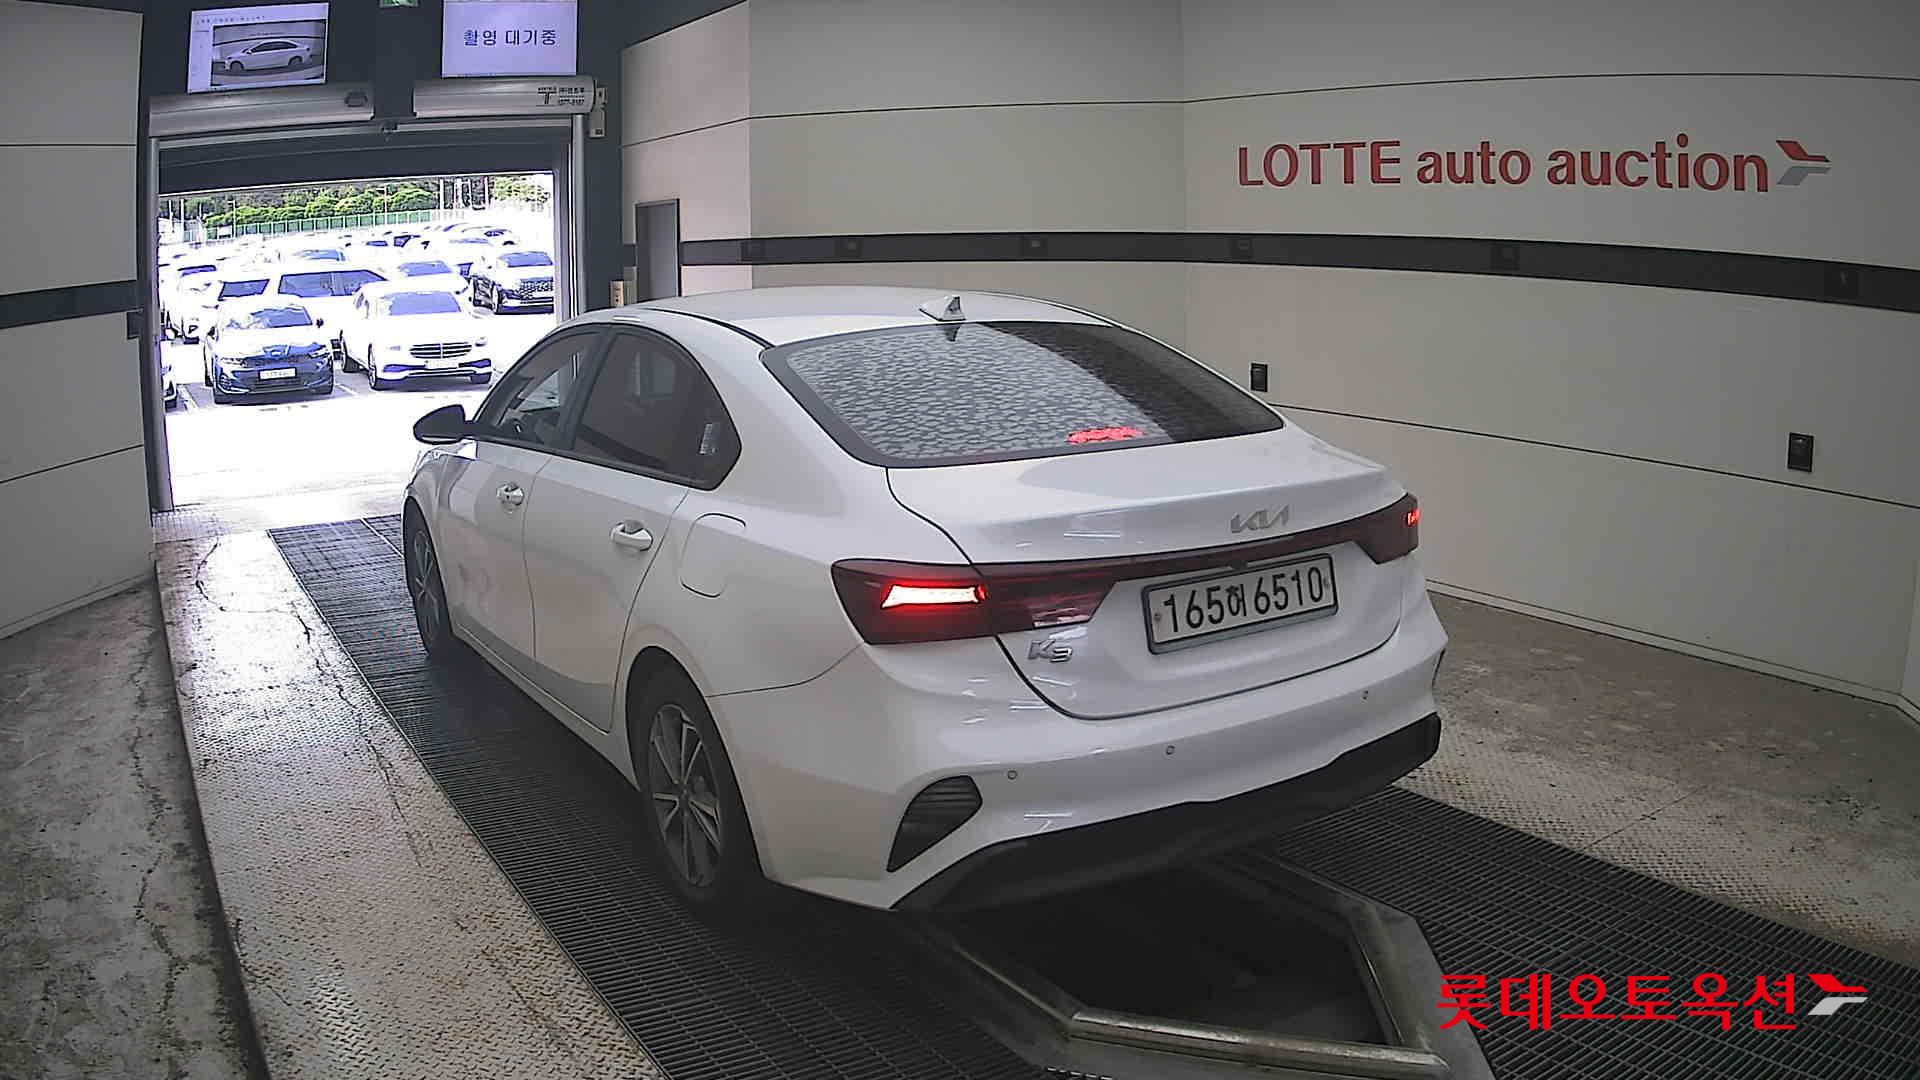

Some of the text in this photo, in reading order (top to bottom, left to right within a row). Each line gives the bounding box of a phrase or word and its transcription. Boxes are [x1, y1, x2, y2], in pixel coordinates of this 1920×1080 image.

[464, 30, 556, 46] 촬영 대기중
[1238, 133, 1769, 192] LOTTE auto auction
[1028, 639, 1073, 662] K3
